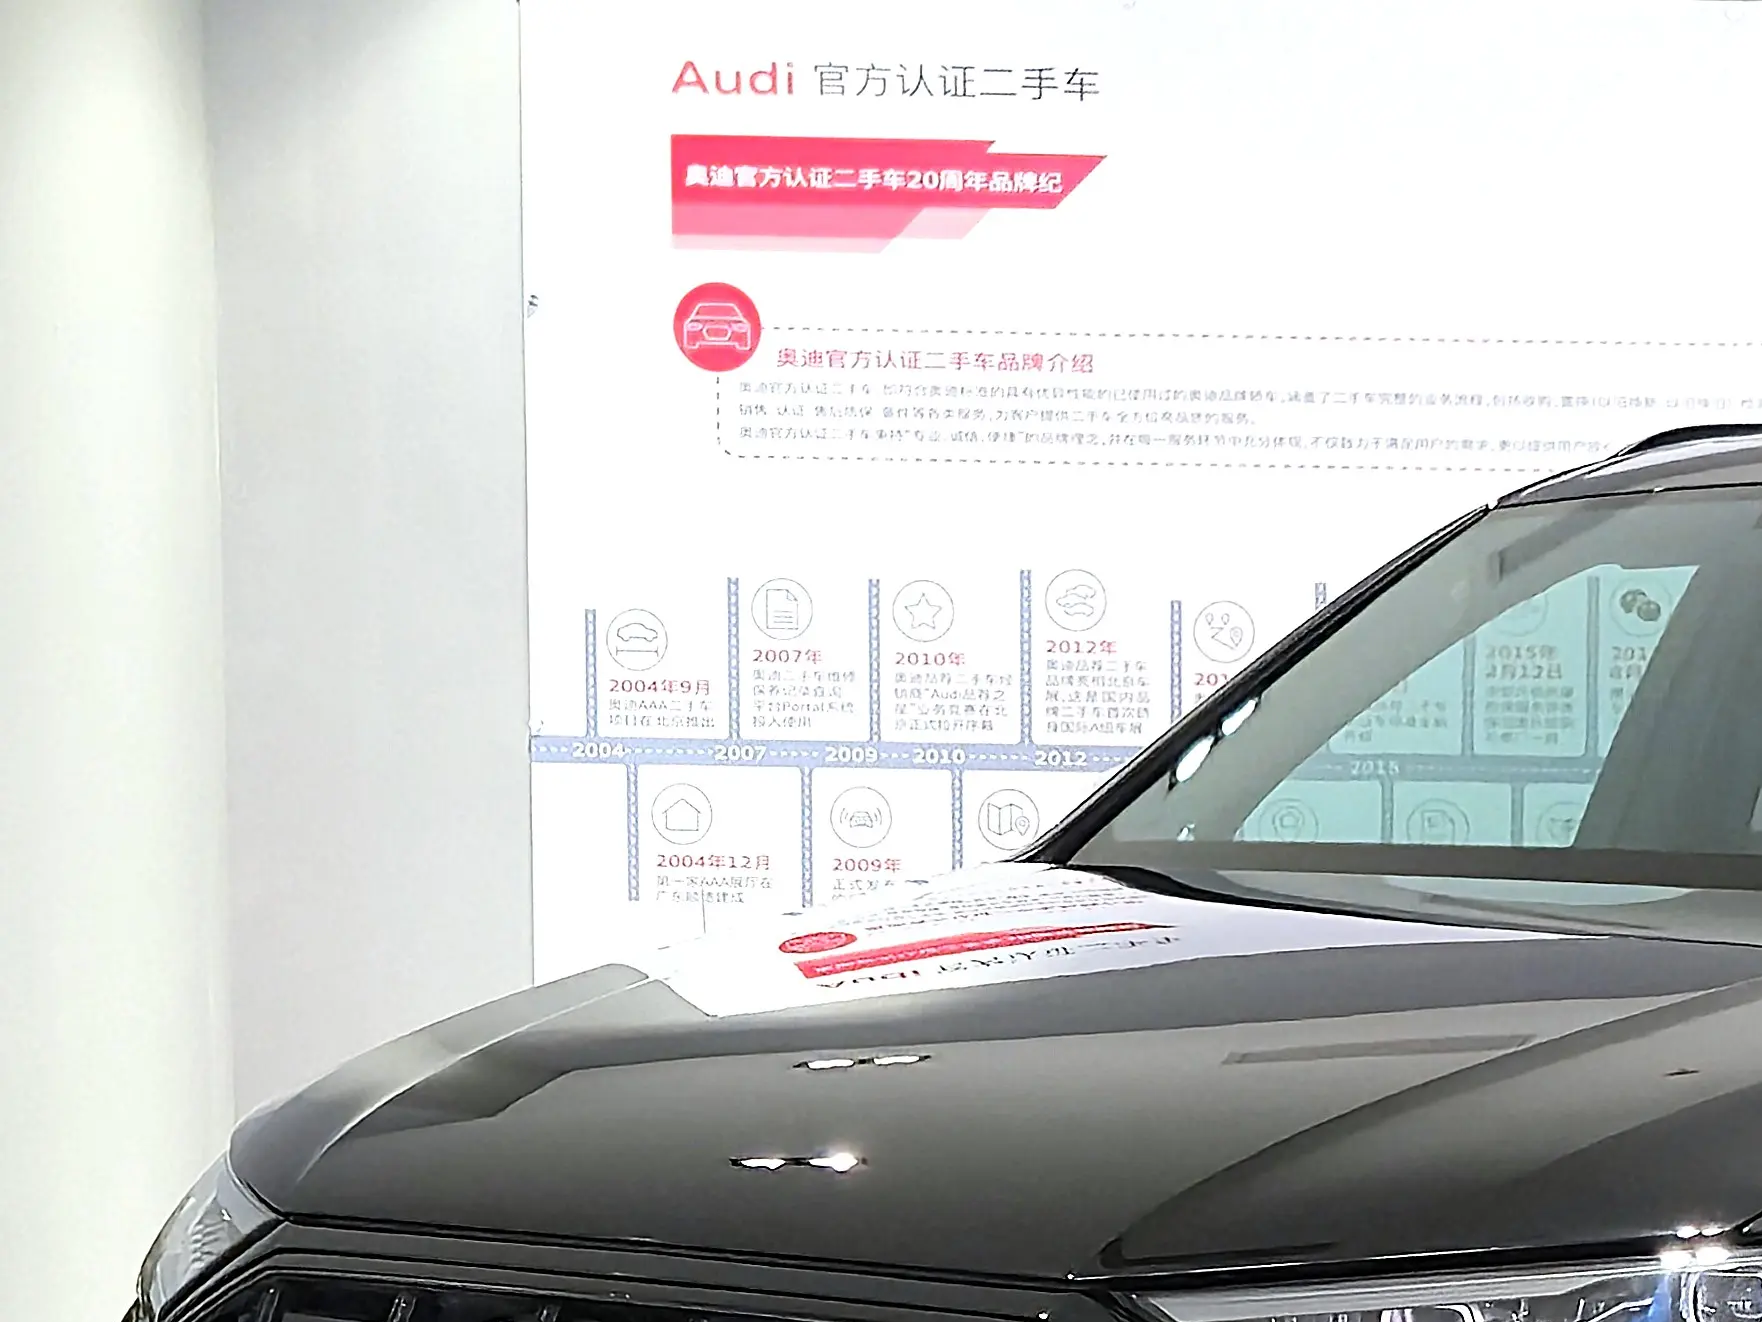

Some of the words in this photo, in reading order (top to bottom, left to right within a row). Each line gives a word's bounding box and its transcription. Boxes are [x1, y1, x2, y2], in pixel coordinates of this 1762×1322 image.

[671, 60, 795, 97] Audi
[813, 61, 1101, 103] 官方认证二手车
[684, 163, 1063, 195] 奥迪官方认证二手车20周年品牌纪
[776, 348, 1095, 374] 奥迪官方认证二手车品牌介绍
[1046, 639, 1117, 655] 2012年
[753, 648, 823, 664] 2007年
[895, 652, 965, 667] 2010年
[609, 679, 711, 696] 2004年9月
[572, 742, 626, 759] 2004
[713, 745, 767, 762] 2007
[825, 746, 878, 763] 2009
[912, 748, 966, 764] 2010
[1035, 750, 1088, 766] 2012
[656, 853, 771, 871] 2004年12月
[832, 858, 902, 873] 2009年
